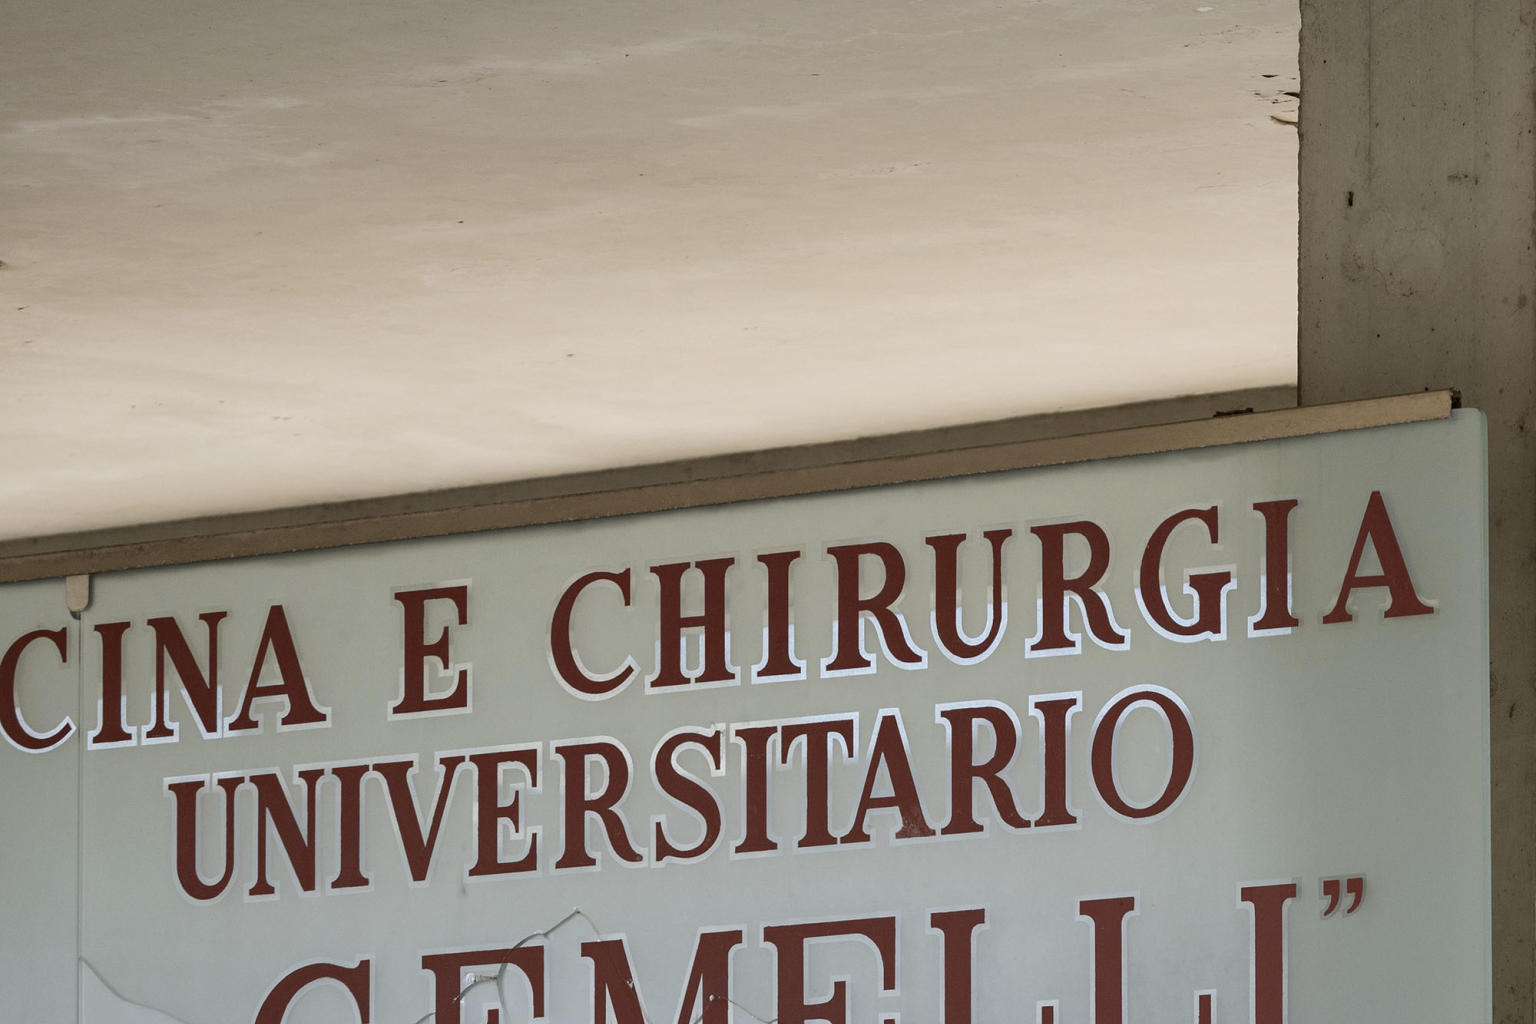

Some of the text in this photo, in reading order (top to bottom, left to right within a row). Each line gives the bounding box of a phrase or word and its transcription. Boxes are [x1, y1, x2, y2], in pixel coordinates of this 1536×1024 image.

[0, 490, 1435, 751] CINA E CHIRURGIA
[167, 689, 1195, 901] UNIVERSITARIO
